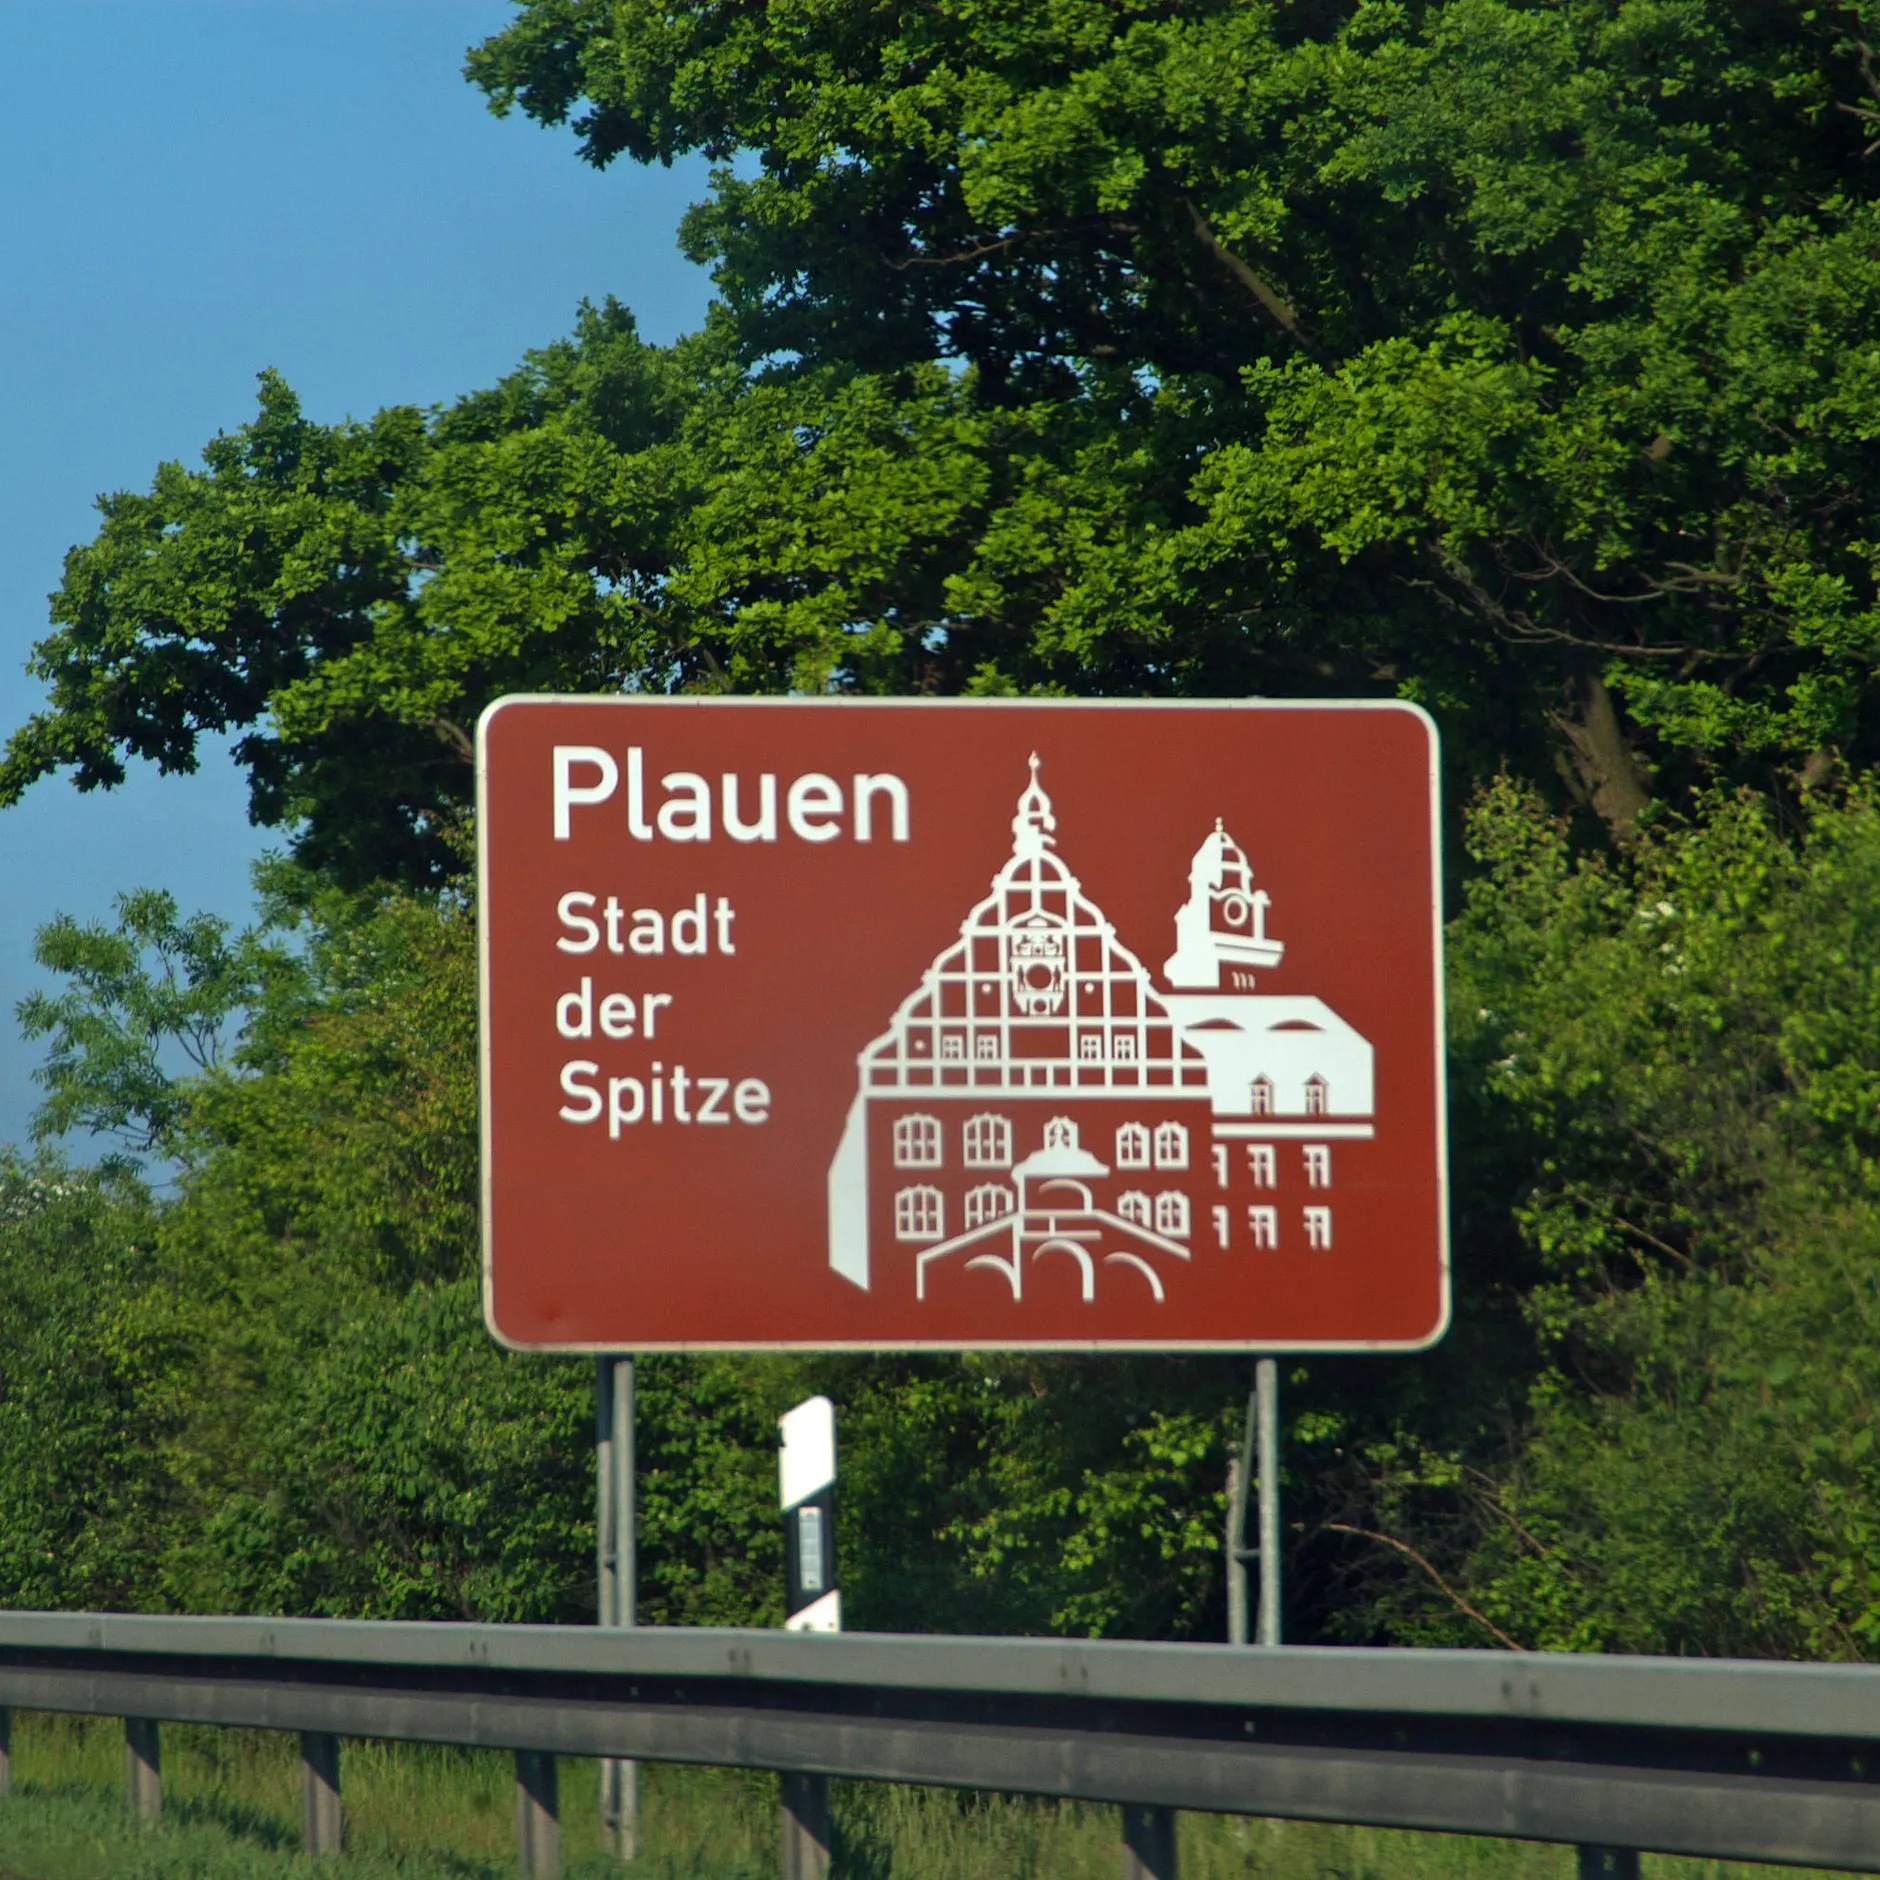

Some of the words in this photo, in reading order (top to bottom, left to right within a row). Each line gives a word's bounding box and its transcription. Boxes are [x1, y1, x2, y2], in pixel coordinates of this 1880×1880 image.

[552, 744, 911, 843] Plauen
[556, 891, 737, 956] Stadt
[556, 976, 673, 1040] der
[558, 1060, 771, 1140] Spitze
